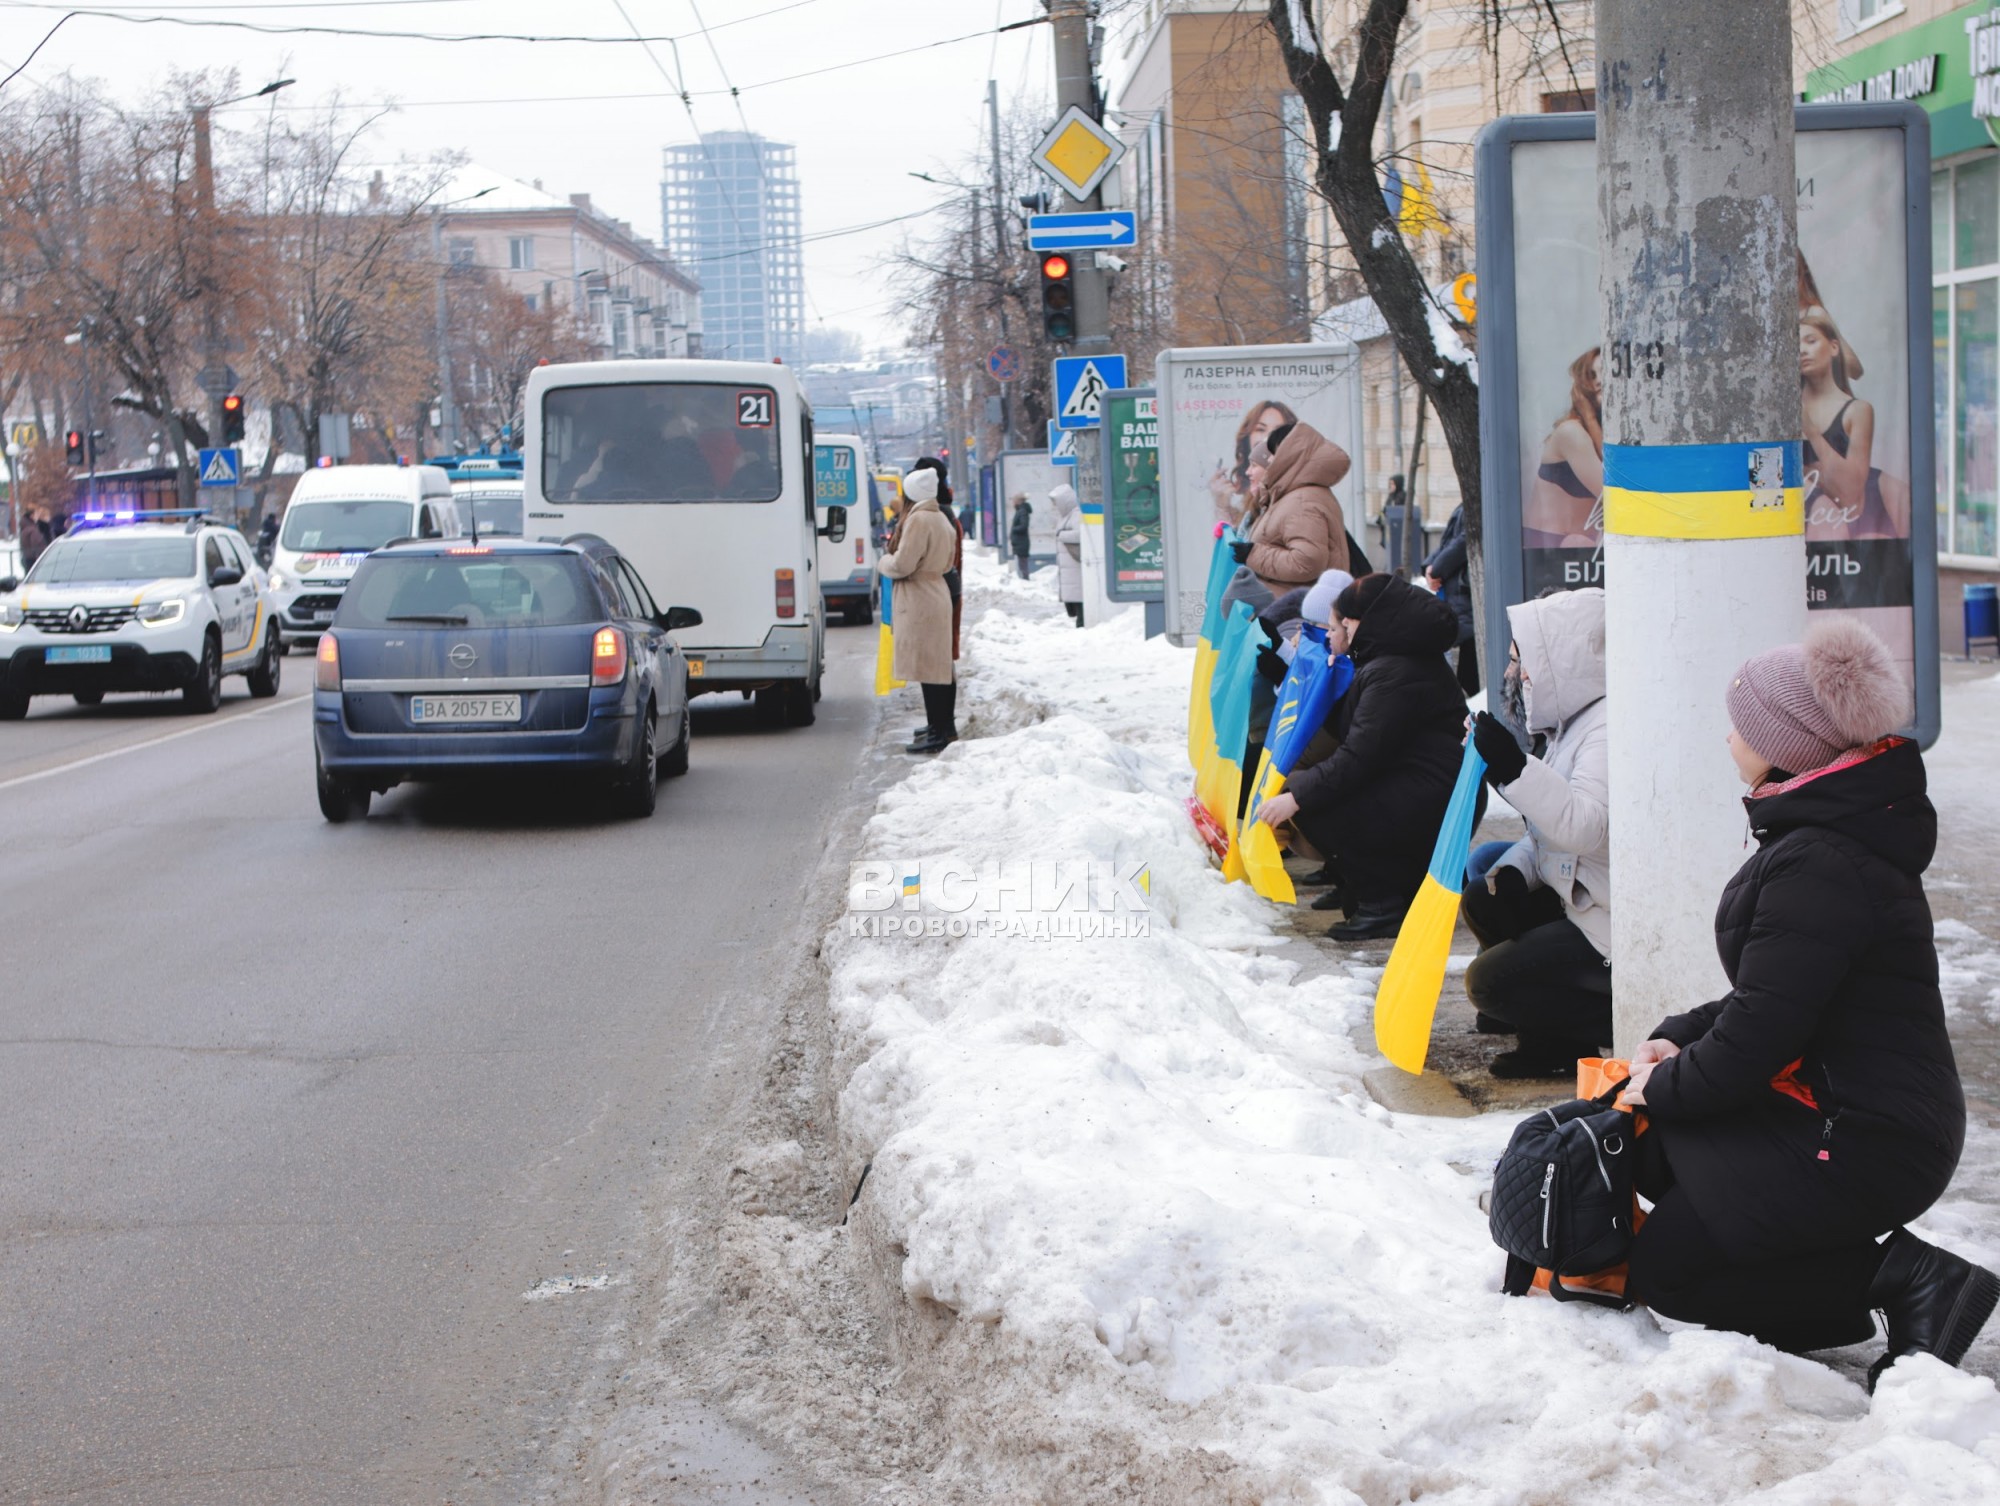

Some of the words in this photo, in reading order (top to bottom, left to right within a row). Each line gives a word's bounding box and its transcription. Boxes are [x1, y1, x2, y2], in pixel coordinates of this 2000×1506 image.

[1893, 55, 1936, 100] ДОМУ
[1184, 367, 1256, 378] ЛАЗЕРНА
[1262, 364, 1335, 377] ЕПІЛЯЦІЯ
[1188, 382, 1204, 390] Без
[1237, 381, 1253, 390] Без
[740, 395, 770, 423] 21
[1176, 400, 1243, 410] LASEROSE
[835, 453, 848, 467] 77
[817, 472, 847, 480] TAXI
[817, 482, 848, 497] 838
[1564, 561, 1604, 583] БІЛ
[1806, 554, 1861, 576] ИЛЬ
[424, 702, 447, 717] BA
[451, 701, 487, 716] 2057
[492, 701, 515, 716] EX
